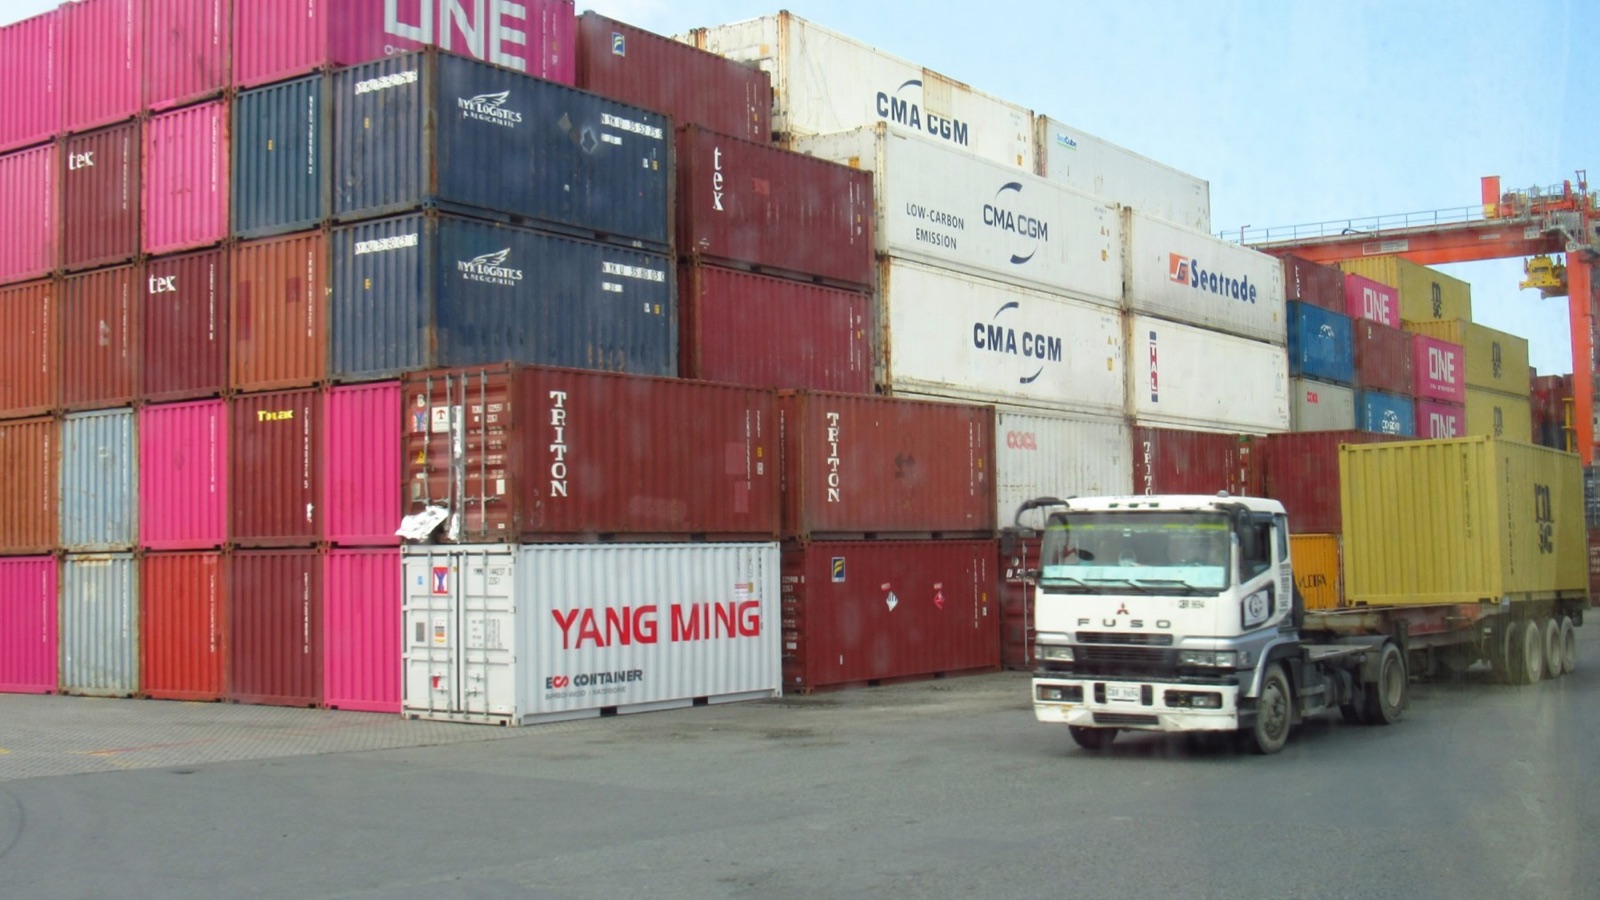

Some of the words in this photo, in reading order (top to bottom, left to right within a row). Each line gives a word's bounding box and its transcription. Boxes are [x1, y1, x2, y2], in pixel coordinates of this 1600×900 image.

[477, 105, 522, 123] LOGISTICS
[876, 91, 921, 130] CMA
[927, 113, 968, 147] CGM
[713, 146, 724, 211] tex
[906, 202, 965, 230] LOW-CARBON
[983, 204, 1015, 233] CMA
[1017, 214, 1048, 241] CGM
[915, 228, 957, 250] EMISSION
[477, 265, 523, 280] LOGISTICS
[1191, 259, 1256, 304] Seatrade
[1363, 287, 1390, 325] ONE
[974, 323, 1017, 354] CMA
[1022, 332, 1062, 362] CGM
[1428, 347, 1455, 384] ONE
[549, 391, 567, 497] TRITON
[1430, 413, 1456, 440] ONE
[826, 412, 840, 502] TRITON
[1143, 441, 1152, 496] TRITO
[551, 605, 658, 650] YANG
[671, 601, 760, 642] MING
[1077, 618, 1171, 629] FUSO
[573, 669, 643, 687] CONTAINER
